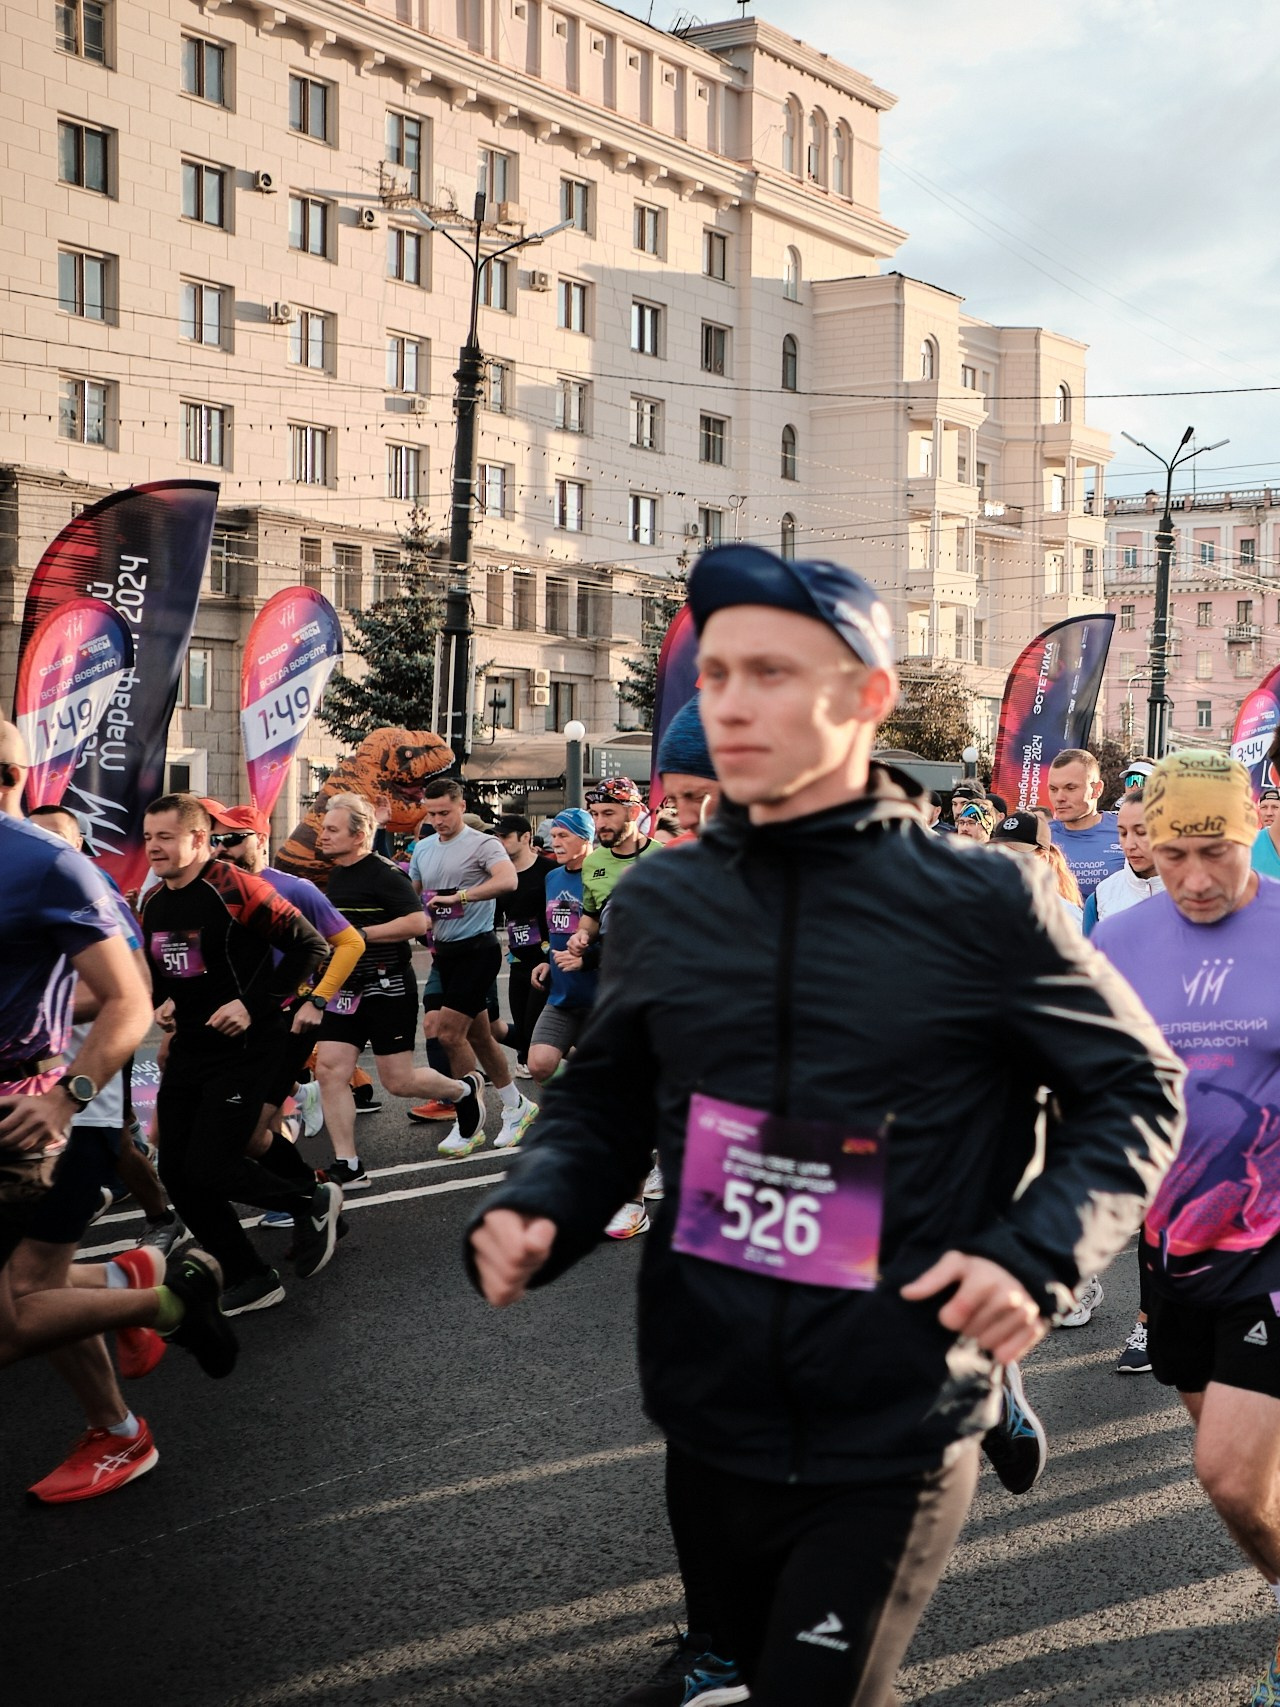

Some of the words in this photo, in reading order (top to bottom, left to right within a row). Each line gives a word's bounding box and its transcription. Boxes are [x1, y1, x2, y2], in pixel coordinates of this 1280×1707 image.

[117, 555, 149, 624] 2024
[258, 643, 289, 665] CASIO
[39, 654, 74, 677] CASIO
[259, 666, 290, 690] ВСЕГДА
[1033, 641, 1055, 715] ЭСТЕТИКА
[37, 698, 92, 750] 1:49
[258, 685, 311, 741] 1:49
[1031, 735, 1043, 761] 2024
[1237, 740, 1263, 762] 3:44
[1179, 755, 1231, 772] Sochi
[1170, 815, 1227, 838] Sochi
[1067, 861, 1105, 869] АССАДОР
[552, 915, 570, 929] 440
[513, 930, 529, 943] 145
[1161, 1017, 1268, 1034] ЕЛЯБИНСКИЙ
[1169, 1036, 1249, 1049] МАРАФОН
[1186, 1054, 1235, 1070] 2024
[720, 1179, 821, 1257] 526
